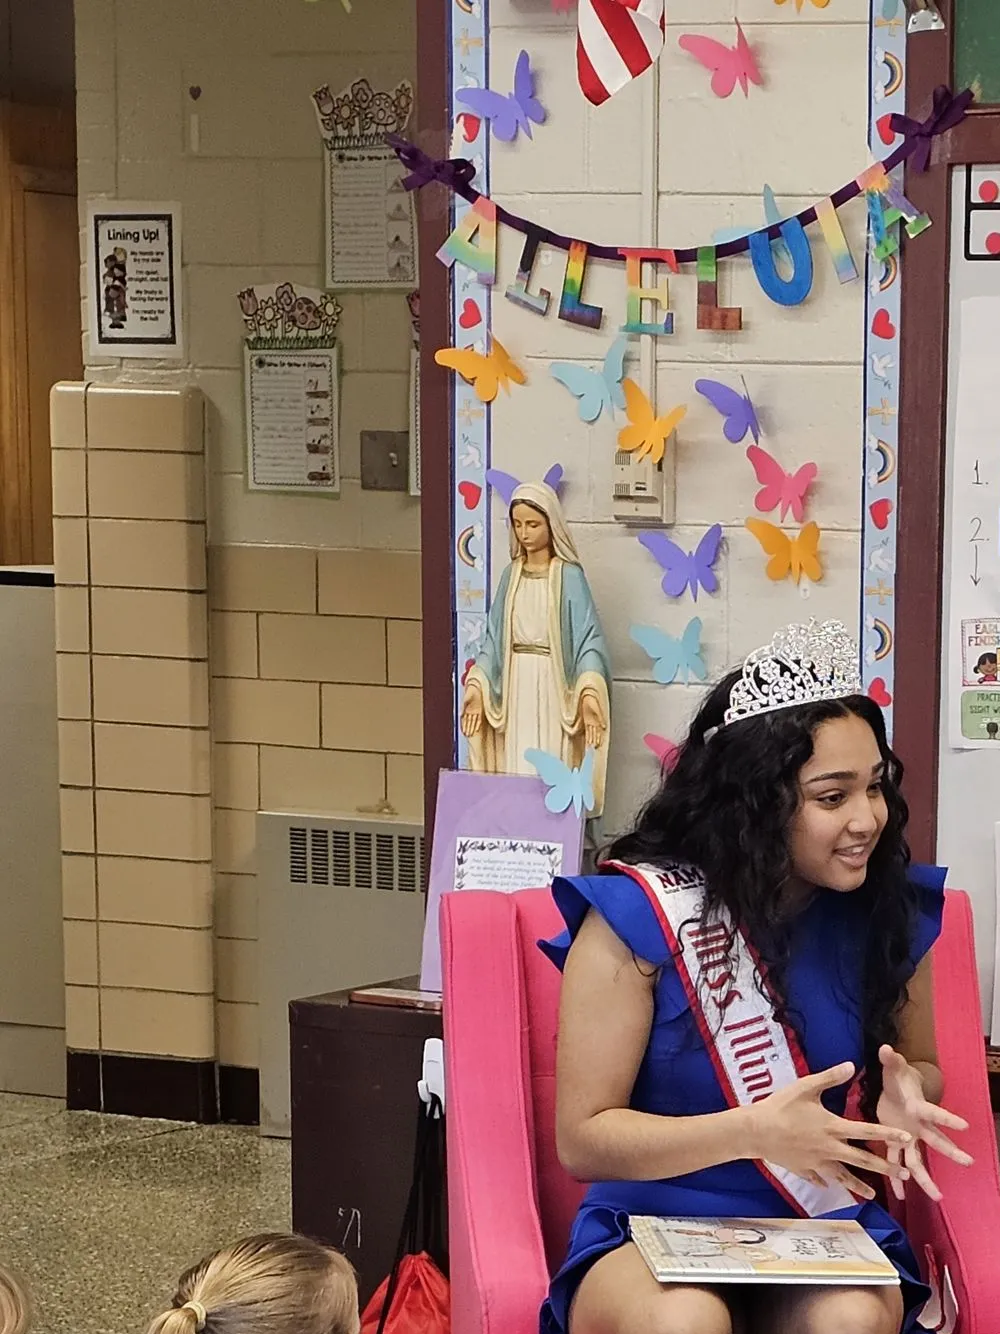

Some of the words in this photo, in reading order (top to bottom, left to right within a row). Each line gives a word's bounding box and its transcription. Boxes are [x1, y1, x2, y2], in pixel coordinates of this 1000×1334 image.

[107, 228, 140, 243] Lining
[142, 228, 160, 243] Up!
[971, 460, 989, 485] 1.
[969, 516, 990, 542] 2.
[656, 866, 704, 889] NAM
[724, 1015, 774, 1104] Illin
